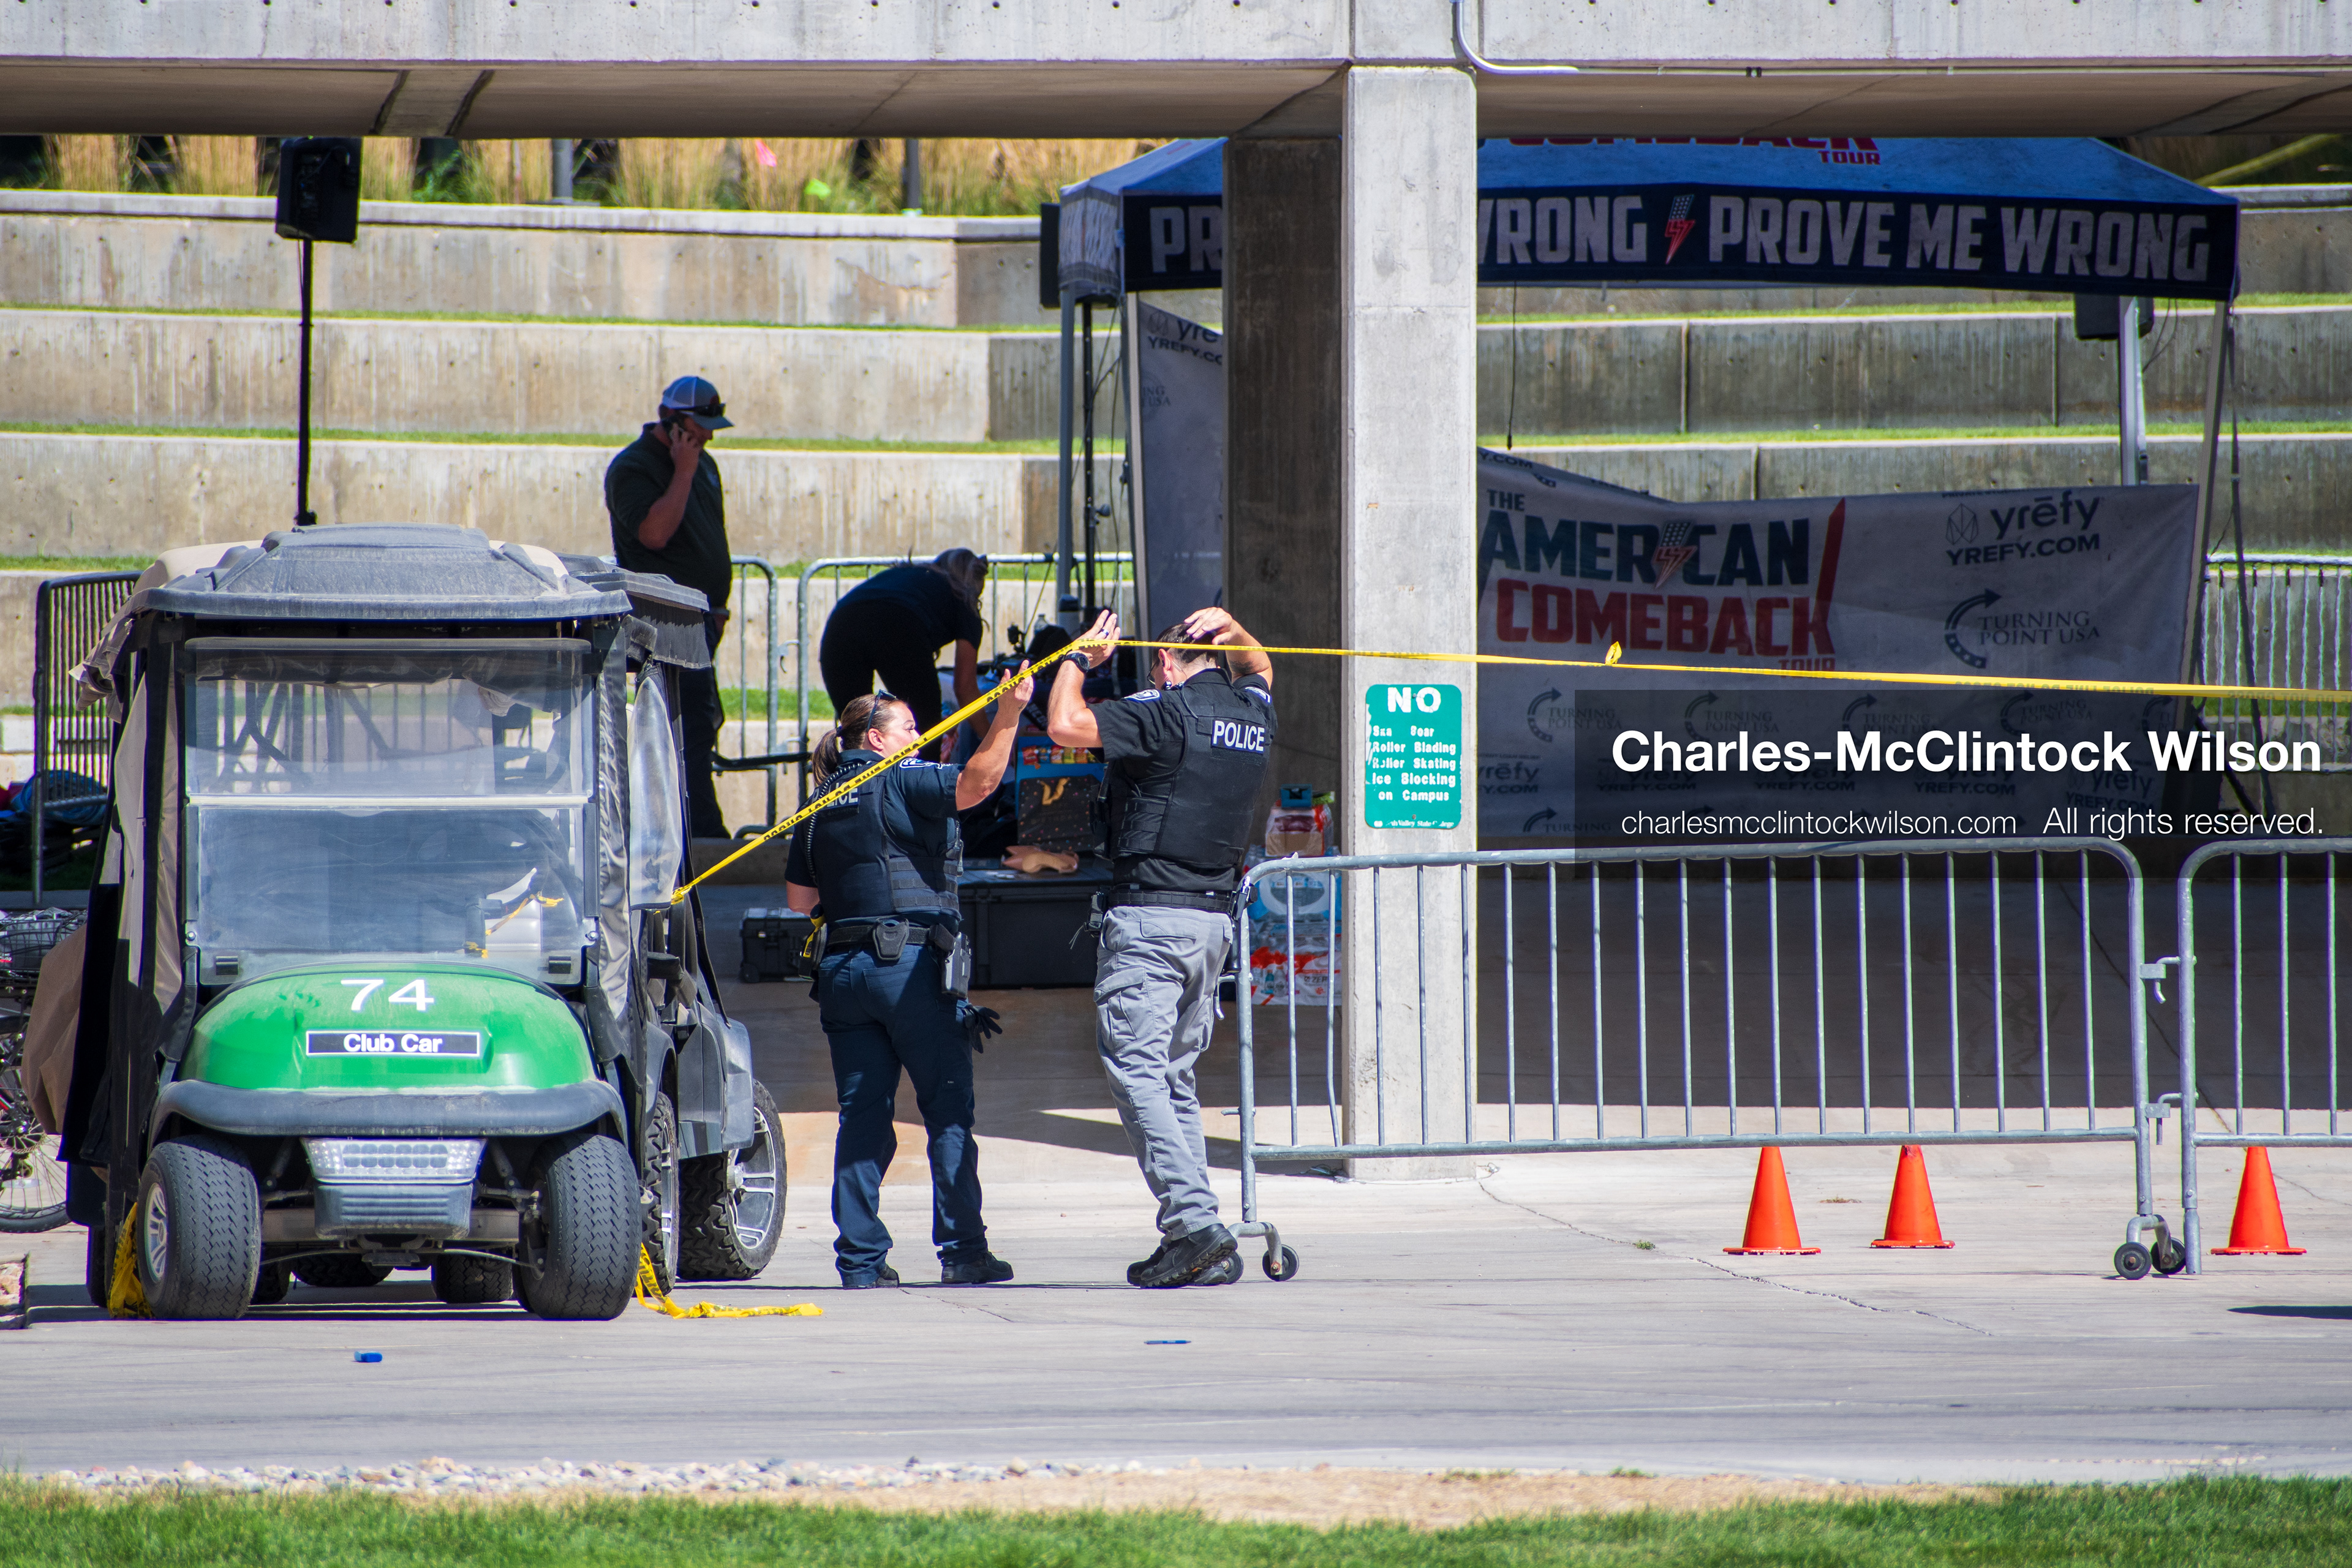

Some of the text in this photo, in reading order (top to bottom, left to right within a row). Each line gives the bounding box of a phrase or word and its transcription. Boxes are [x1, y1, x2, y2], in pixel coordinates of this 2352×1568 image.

[1817, 150, 1881, 165] TOUR
[1709, 195, 2209, 282] PROVE ME WRONG
[1487, 489, 1525, 511] THE
[1946, 533, 2100, 567] YREFY.COM
[1496, 551, 1841, 657] COMEBACK
[1978, 611, 2090, 631] TURNING
[1980, 624, 2100, 646] POINT USA
[1387, 687, 1441, 713] NO
[1213, 720, 1265, 752] POLICE
[1373, 741, 1457, 756] Roller Blading
[1413, 757, 1457, 772] Skating
[1372, 772, 1457, 788] Ice Blocking
[812, 782, 858, 807] PLICE
[1378, 790, 1450, 803] on Campus
[341, 979, 434, 1011] 74
[344, 1033, 443, 1052] Club Car
